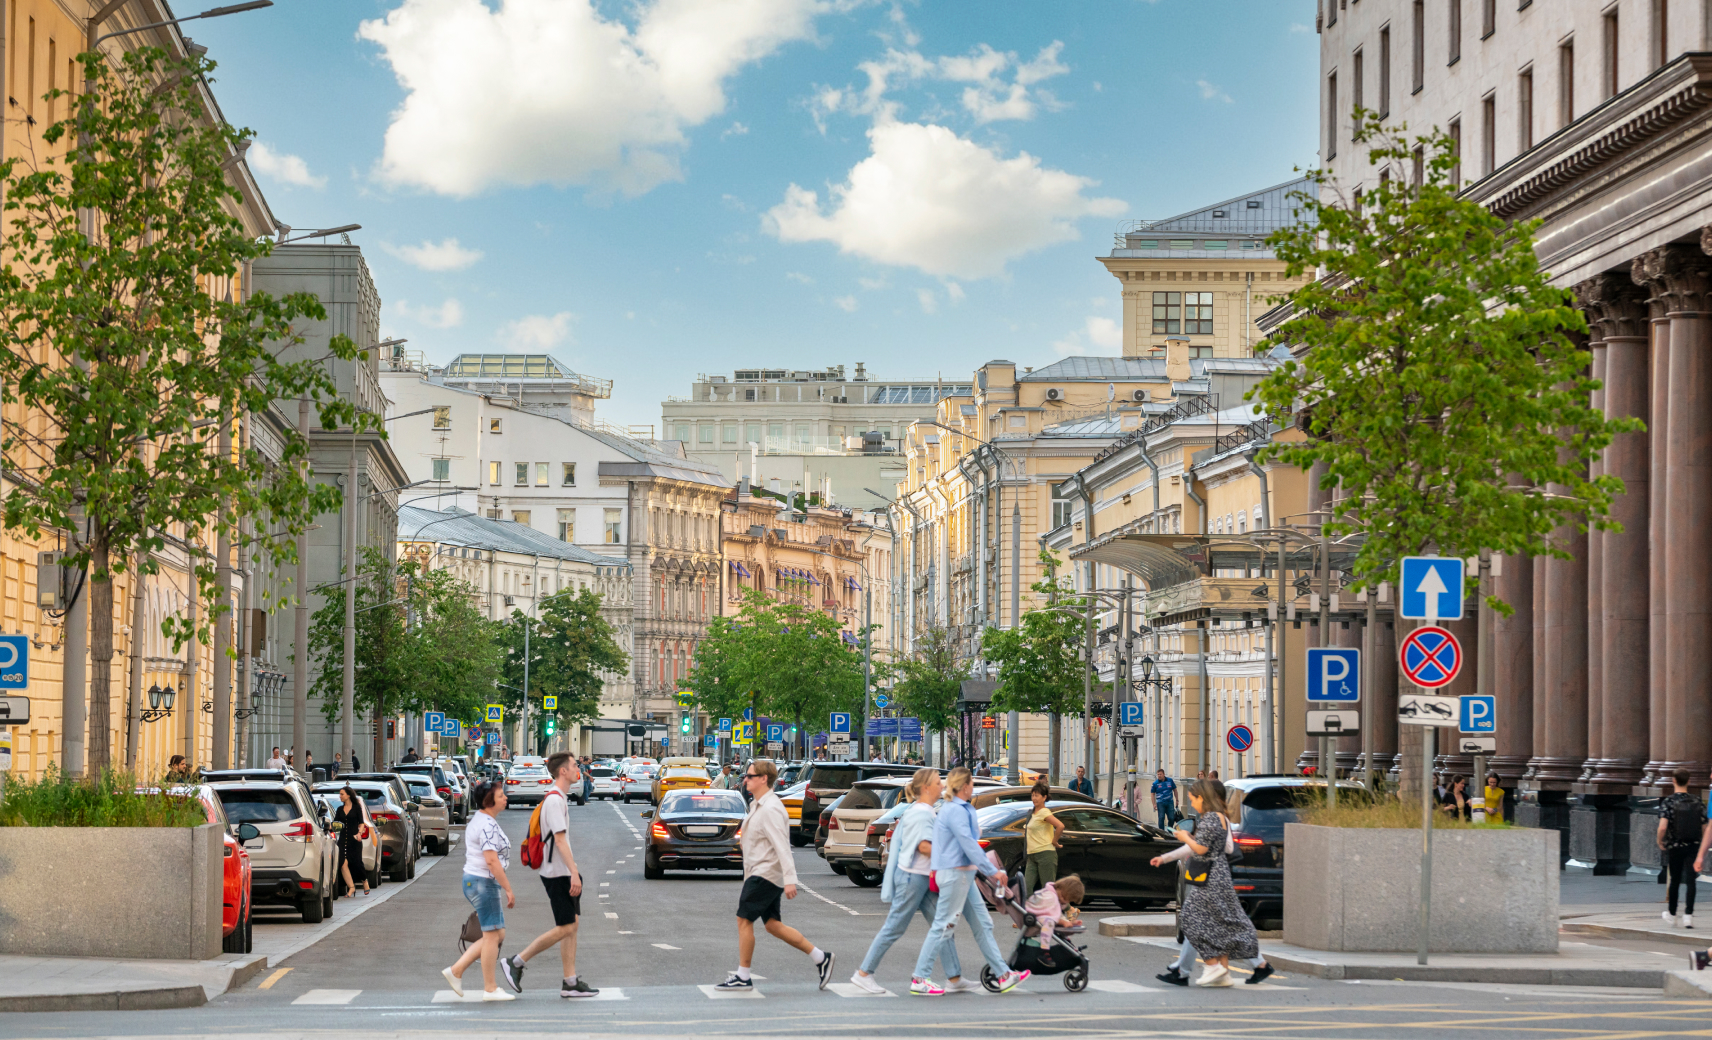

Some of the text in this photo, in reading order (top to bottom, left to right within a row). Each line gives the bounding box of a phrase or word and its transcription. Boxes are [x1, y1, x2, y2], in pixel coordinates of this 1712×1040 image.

[1322, 655, 1350, 695] P
[1127, 705, 1139, 723] P
[1469, 700, 1489, 728] P
[430, 714, 441, 730] P
[445, 721, 455, 735] P
[723, 720, 730, 729] P
[835, 715, 846, 730] P
[707, 736, 714, 745] P
[771, 727, 780, 739] P
